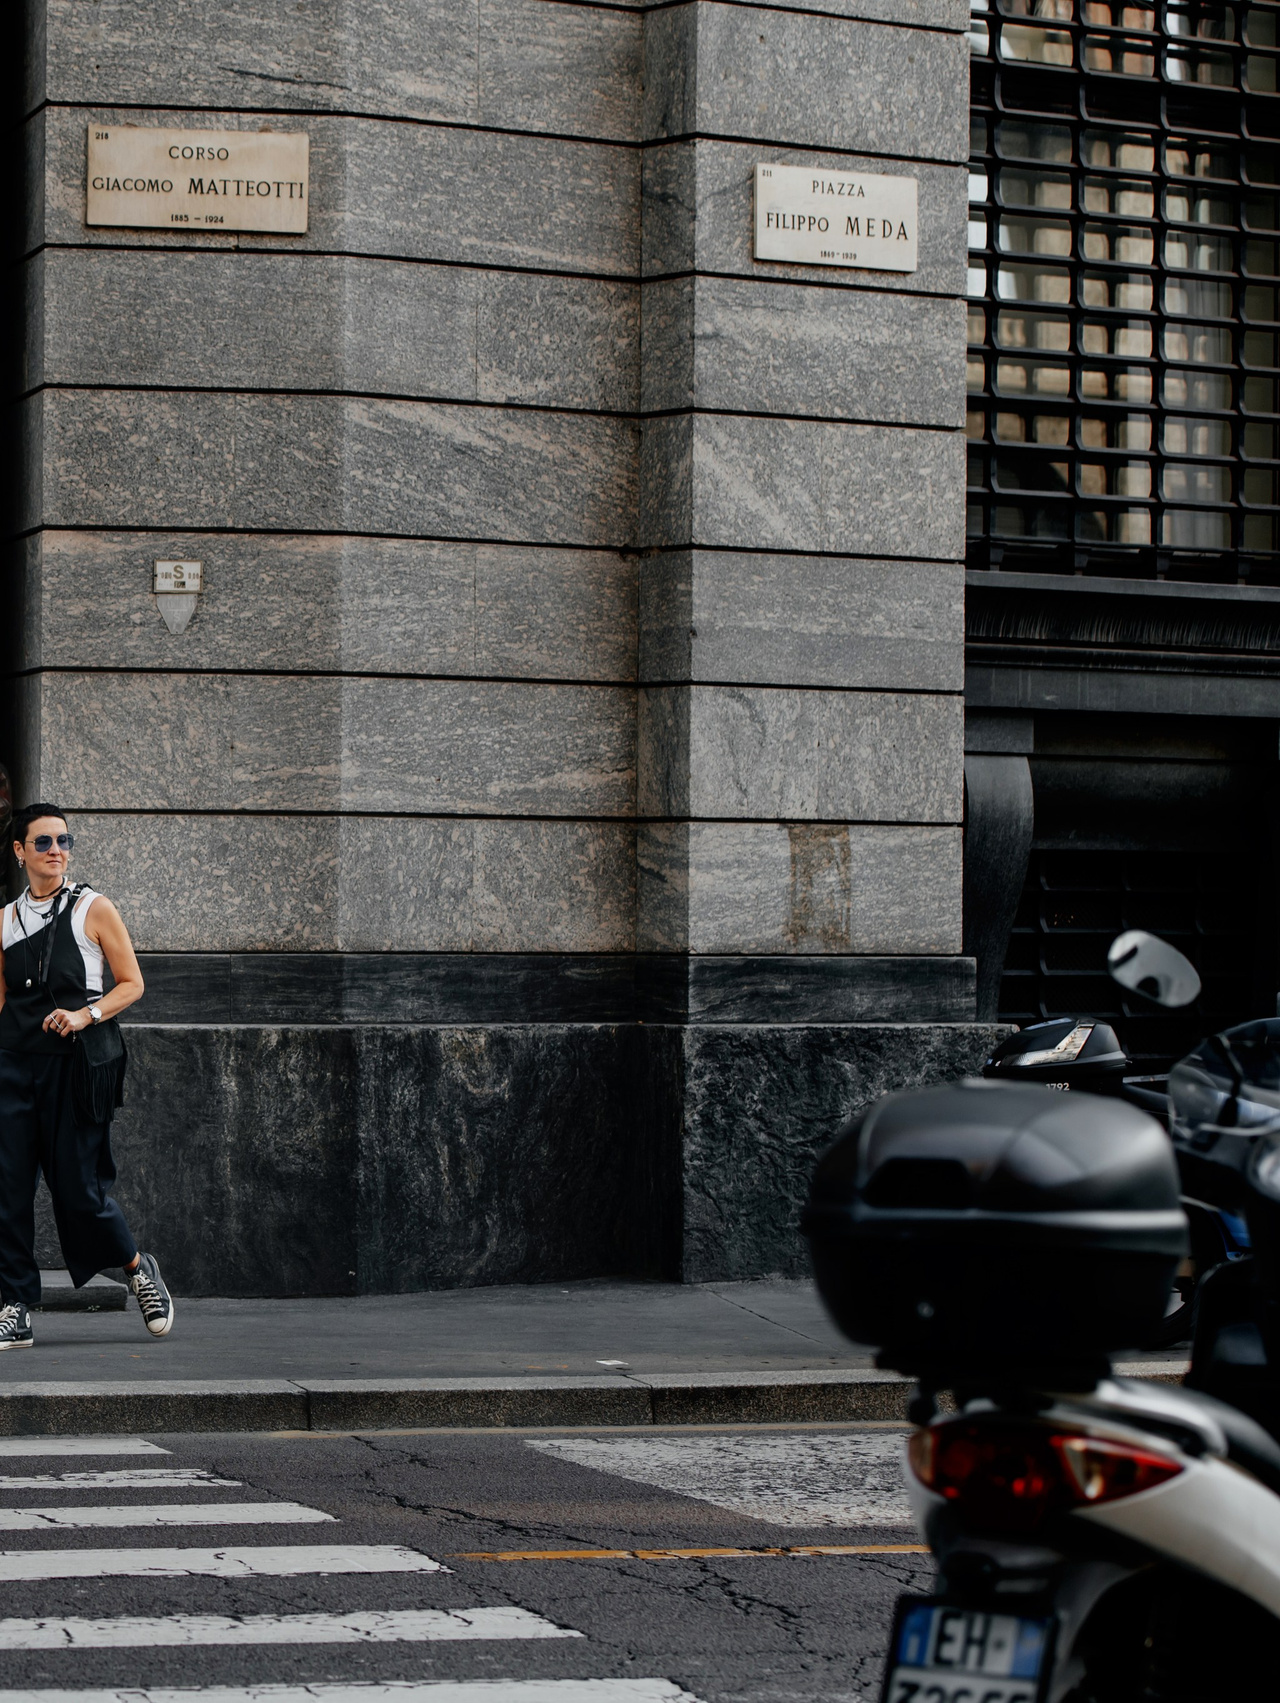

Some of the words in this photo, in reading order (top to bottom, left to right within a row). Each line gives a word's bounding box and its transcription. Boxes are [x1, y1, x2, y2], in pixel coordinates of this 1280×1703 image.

[95, 131, 109, 140] 218
[168, 146, 229, 161] CORSO
[92, 177, 174, 193] GIACOMO
[188, 178, 304, 198] MATTEOTTI
[812, 180, 865, 197] PIAZZA
[170, 213, 189, 222] 1885
[205, 215, 224, 223] 1924
[766, 212, 829, 232] FILIPPO
[845, 216, 909, 240] MEDA
[842, 252, 857, 260] 1939
[173, 565, 184, 579] S
[934, 1611, 991, 1667] EH
